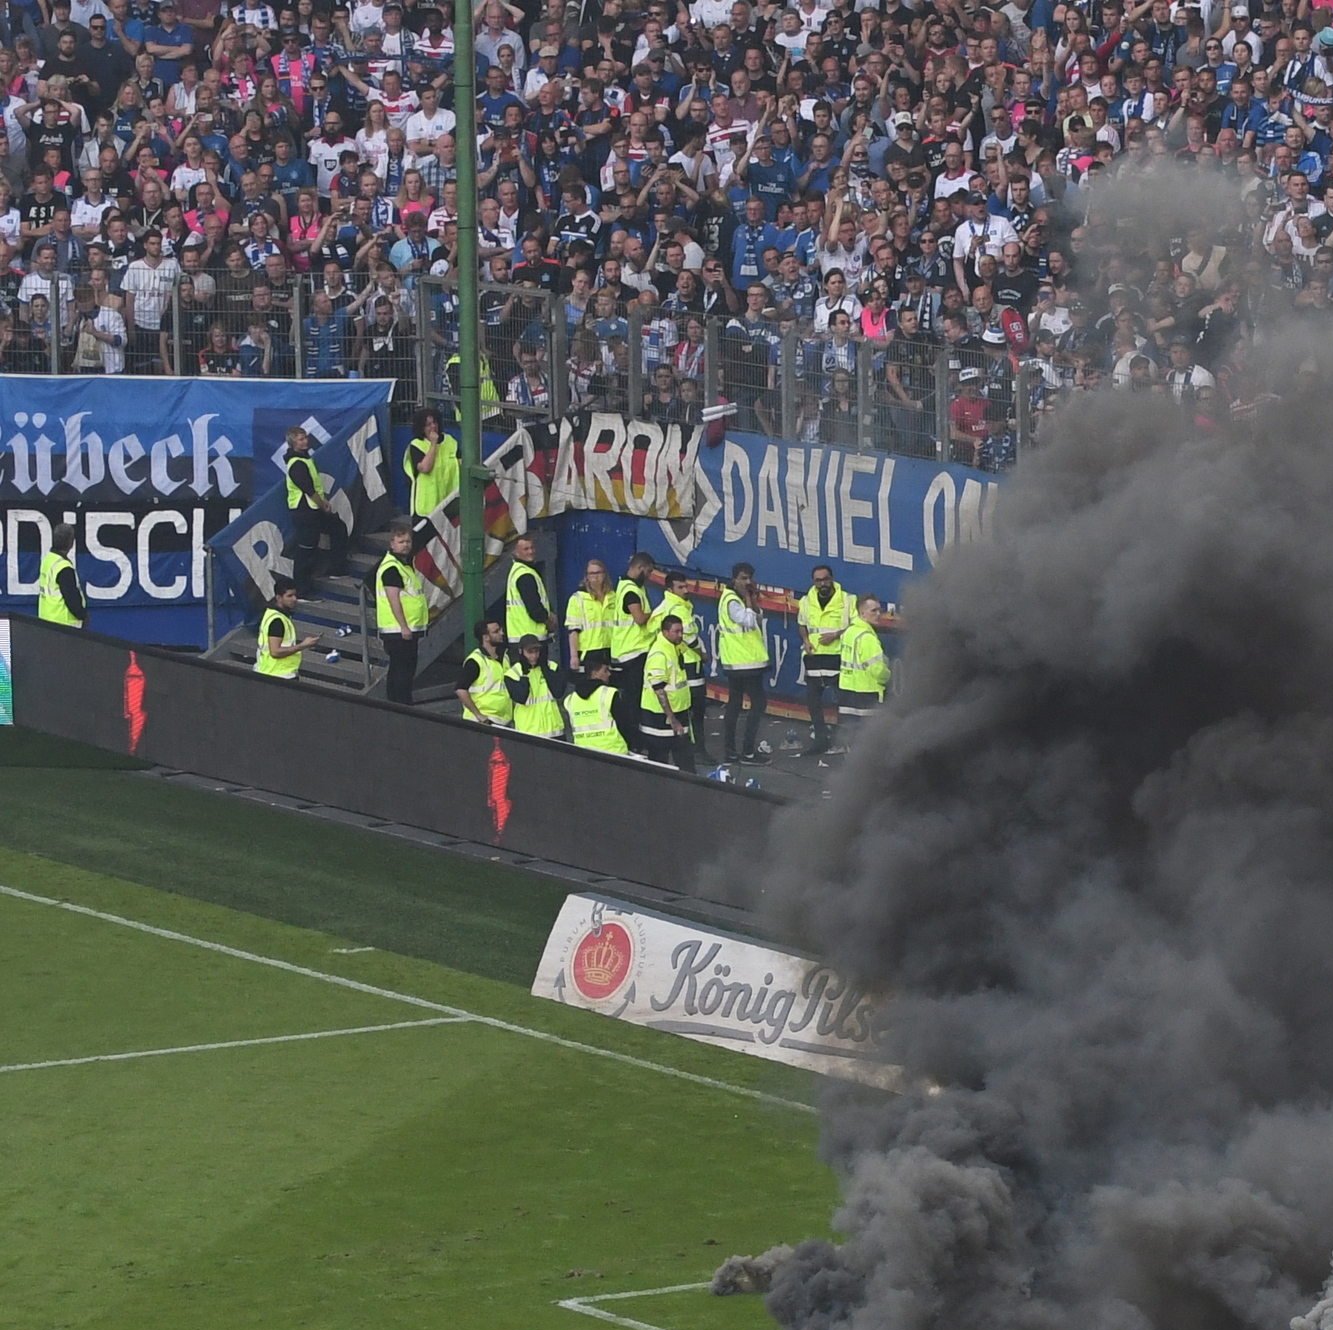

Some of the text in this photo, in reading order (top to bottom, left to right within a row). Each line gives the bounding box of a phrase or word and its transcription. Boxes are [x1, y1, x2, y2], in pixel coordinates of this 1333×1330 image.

[0, 411, 241, 498] übeck
[720, 440, 913, 571] DANIEL
[650, 940, 798, 1045] König
